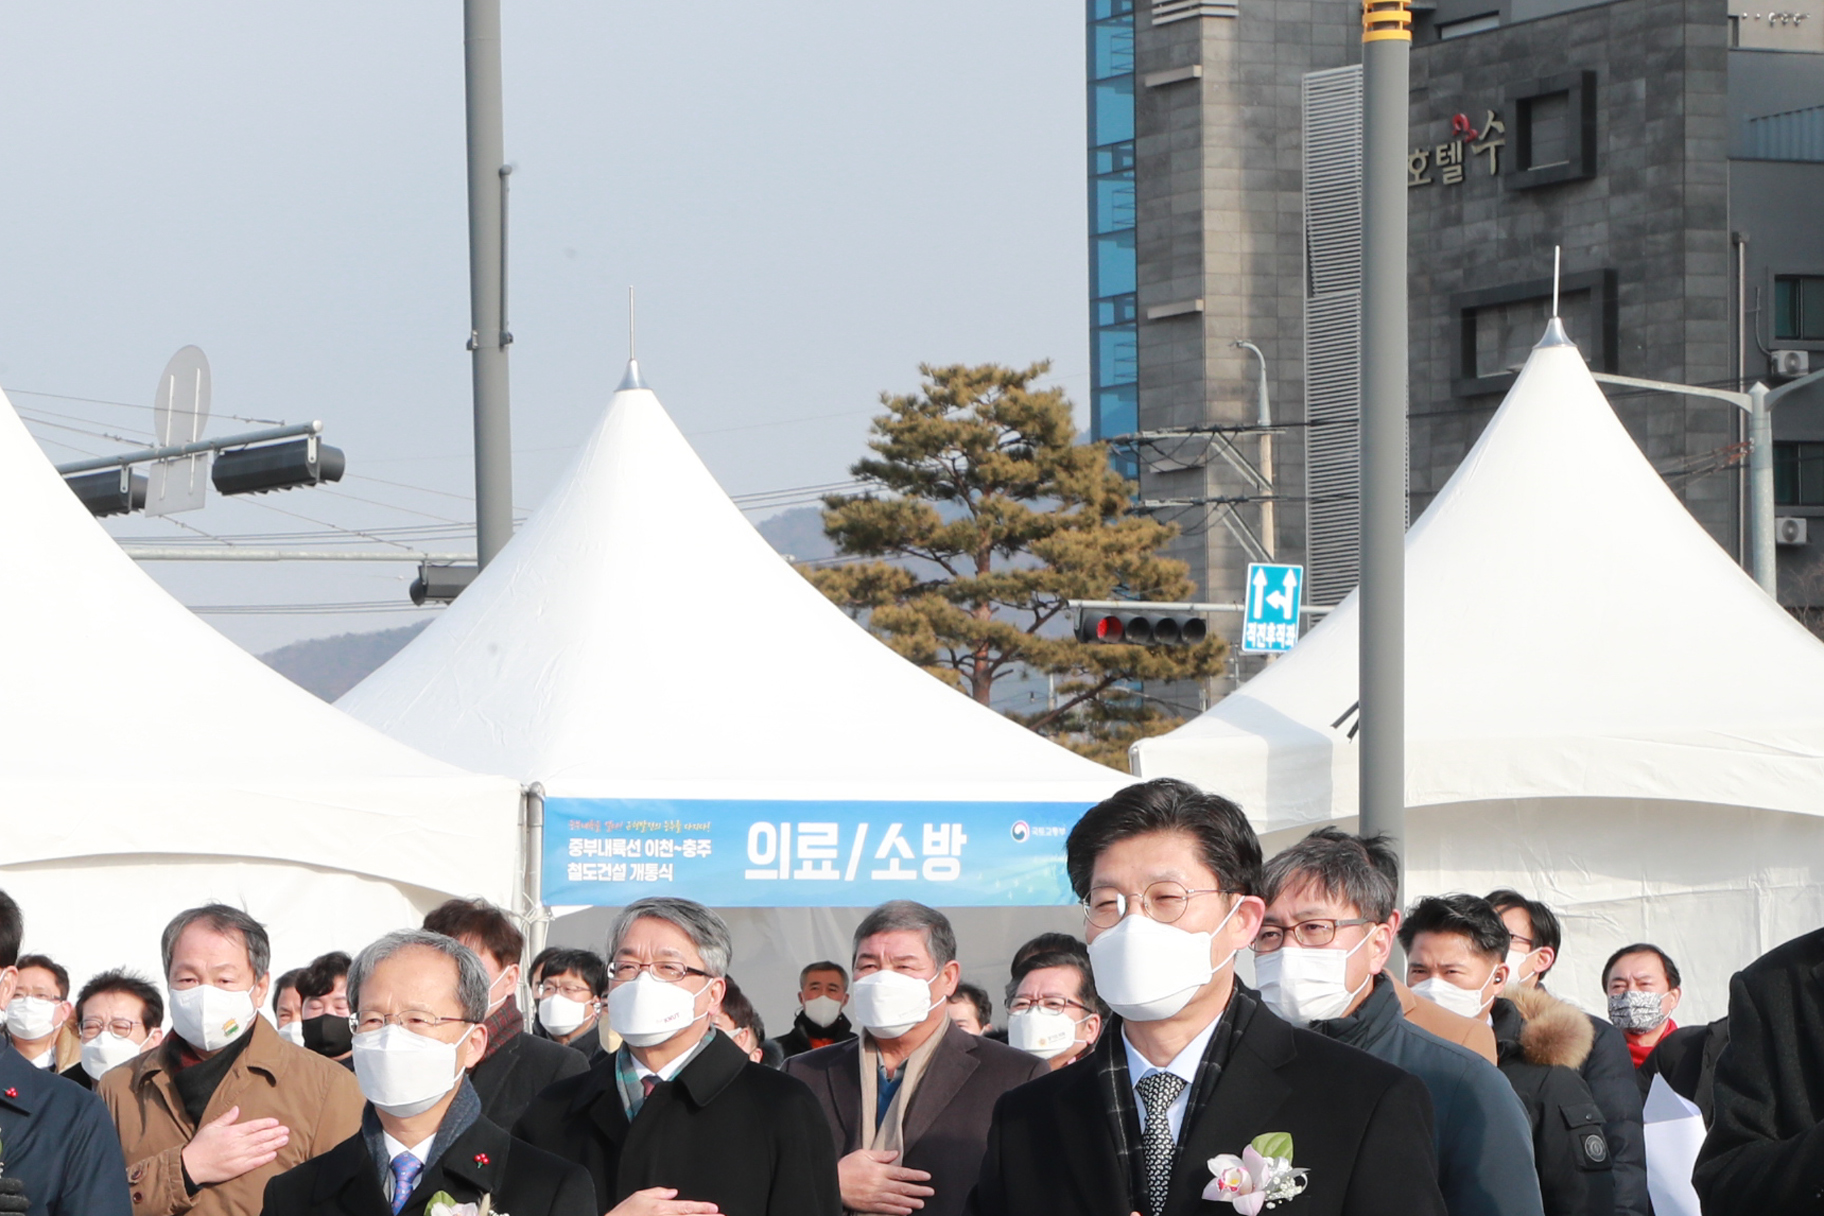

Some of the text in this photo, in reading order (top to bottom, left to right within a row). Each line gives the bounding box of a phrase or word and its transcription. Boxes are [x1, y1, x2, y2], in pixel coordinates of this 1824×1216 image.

[1408, 109, 1506, 187] 호텔 수
[568, 837, 712, 858] 중부내륙선 이천~충주
[745, 821, 968, 882] 의료/소방
[567, 862, 674, 882] 철도건설 개통식
